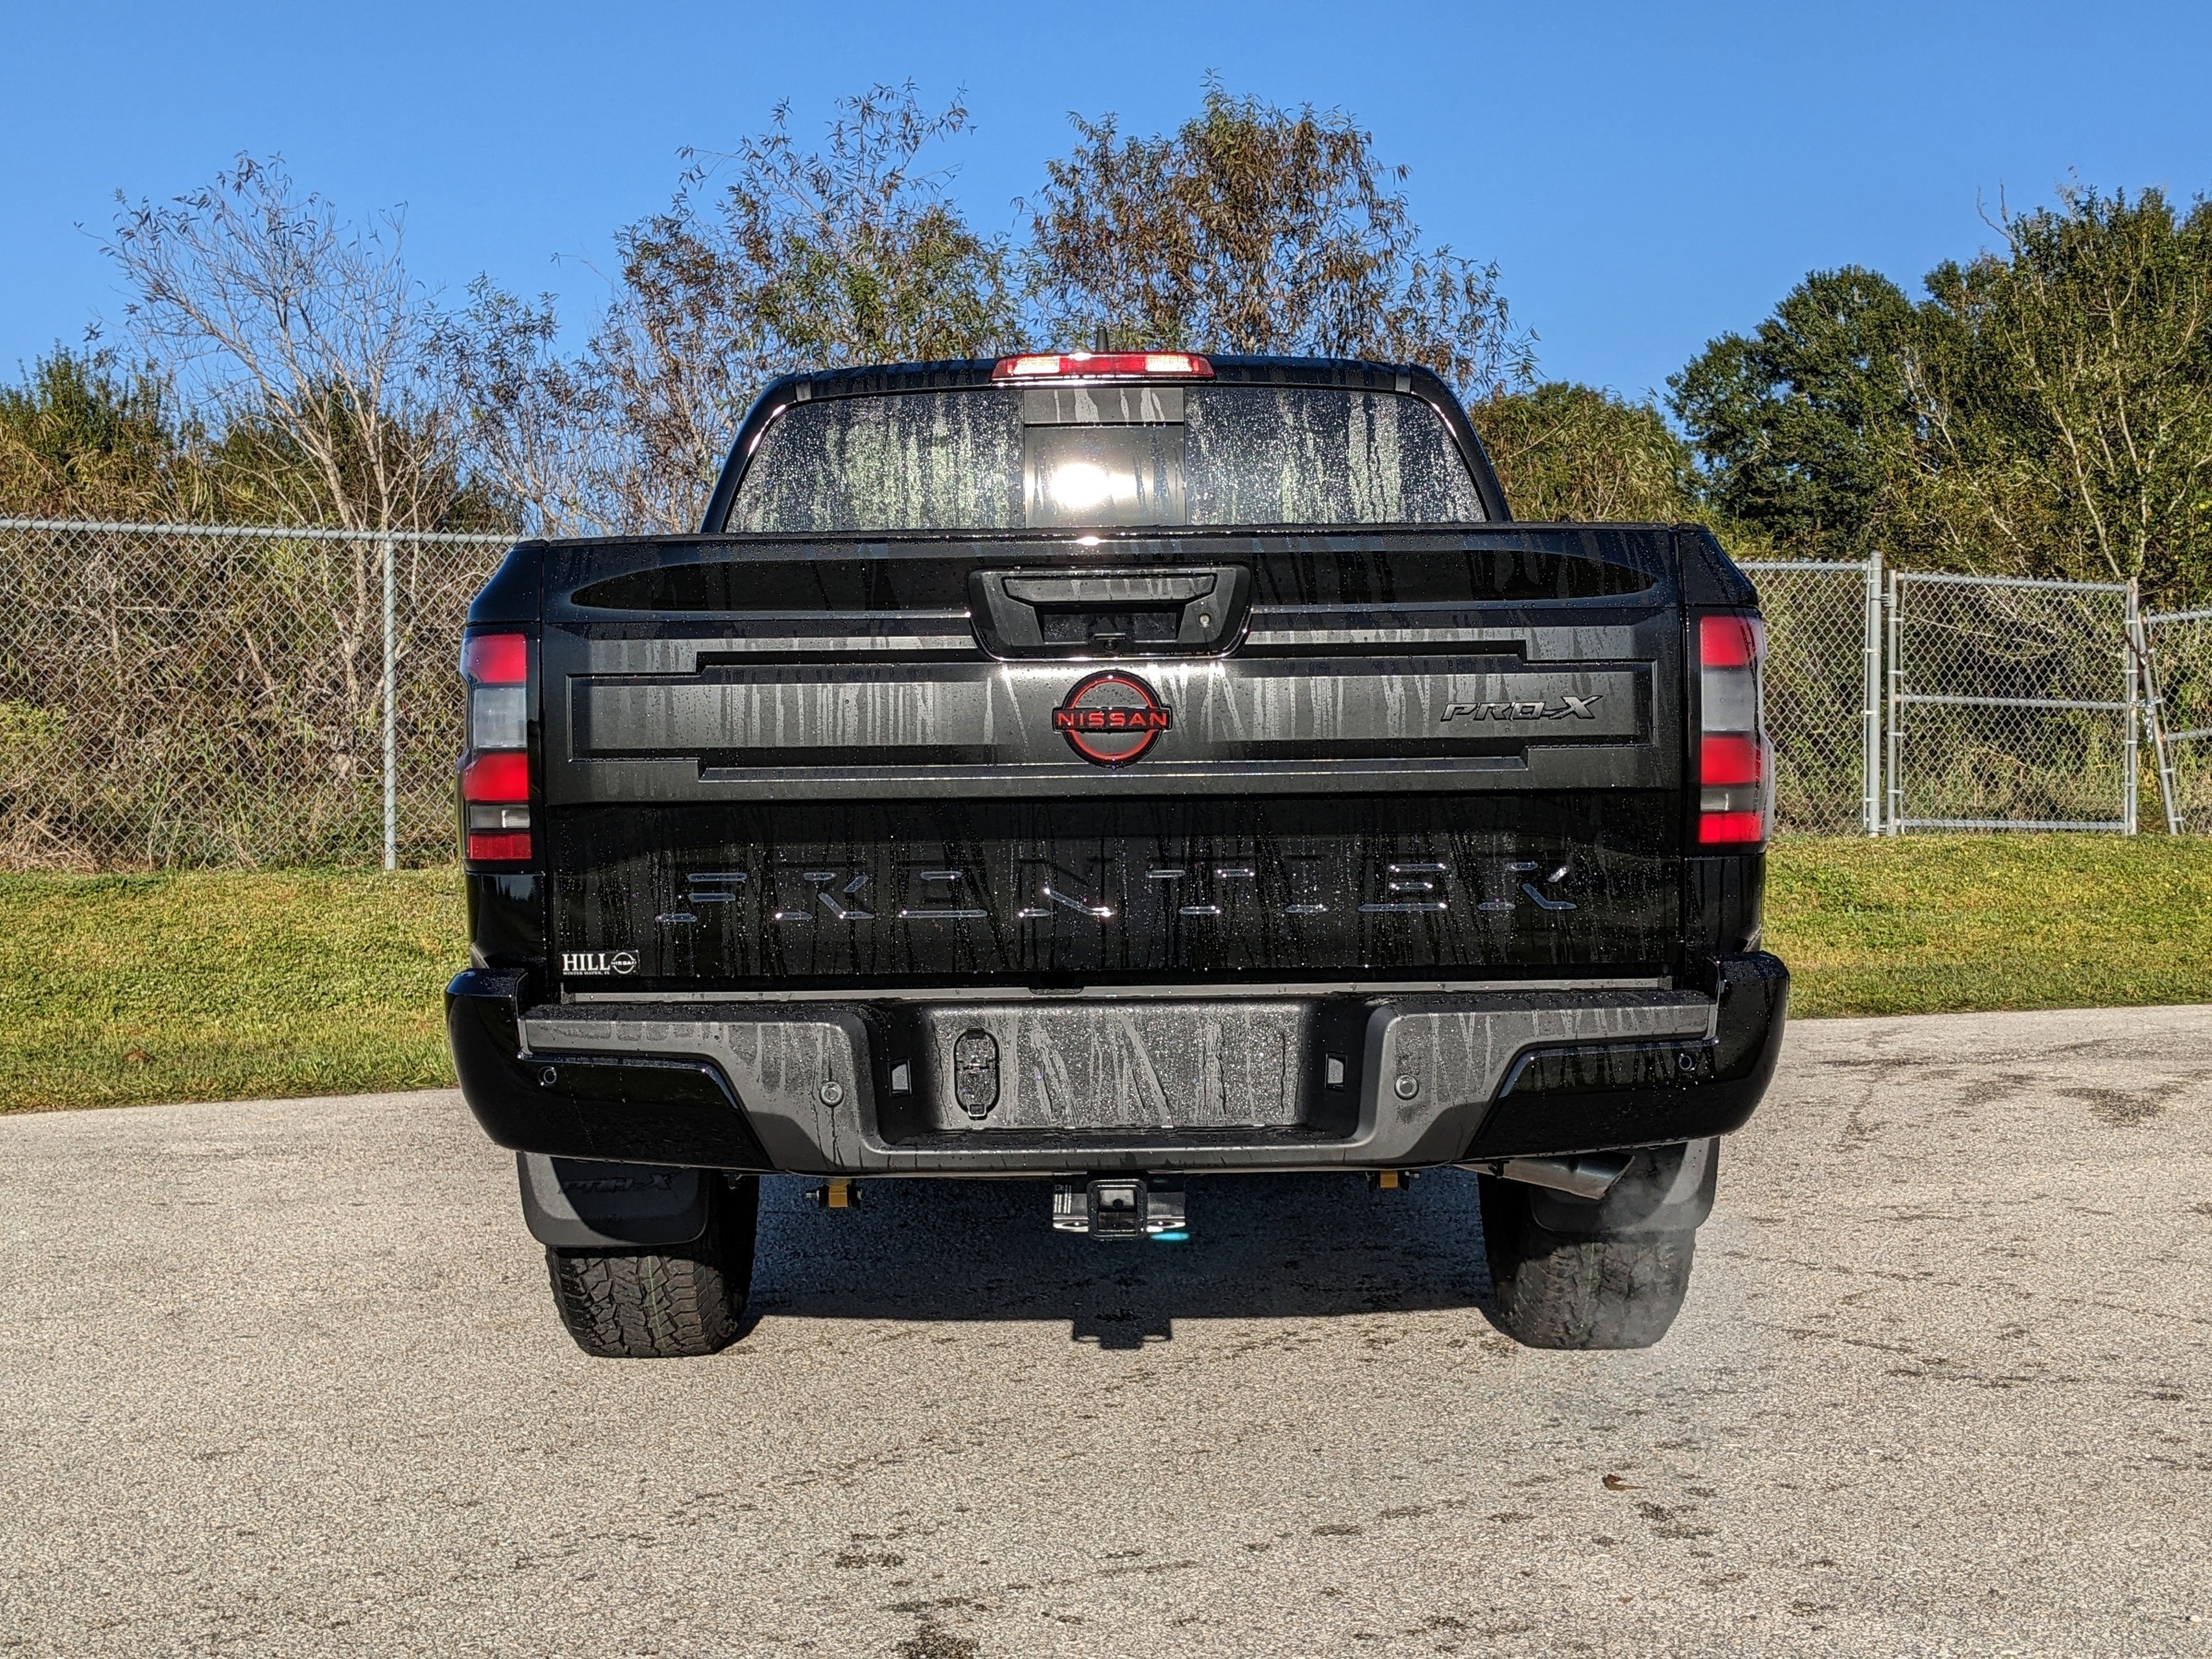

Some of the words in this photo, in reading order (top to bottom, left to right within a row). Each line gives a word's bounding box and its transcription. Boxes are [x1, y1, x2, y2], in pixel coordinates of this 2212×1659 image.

[1440, 695, 1604, 722] PRO-X
[1056, 712, 1167, 728] NISSAN
[654, 857, 1578, 923] FRONTIER
[562, 953, 611, 971] HILL
